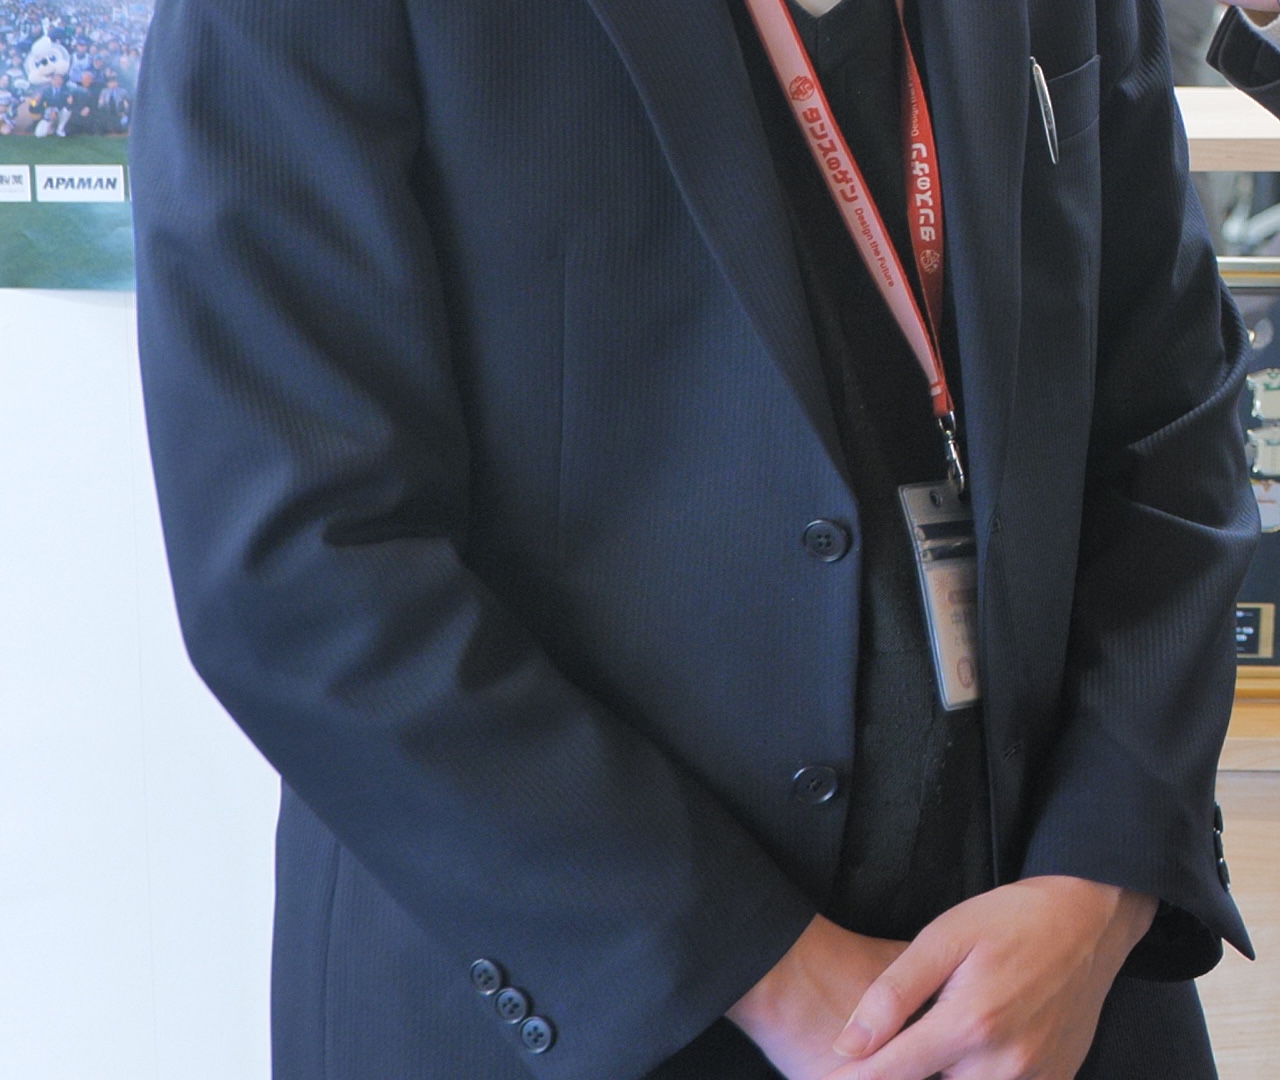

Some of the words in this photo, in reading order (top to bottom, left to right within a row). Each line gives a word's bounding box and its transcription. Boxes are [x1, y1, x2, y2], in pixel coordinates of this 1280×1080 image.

[43, 177, 118, 190] APAMAN
[802, 107, 859, 203] タンスのゲン
[911, 142, 936, 242] タンスのゲン
[854, 207, 873, 241] Design
[867, 241, 881, 257] the
[878, 257, 895, 288] Future
